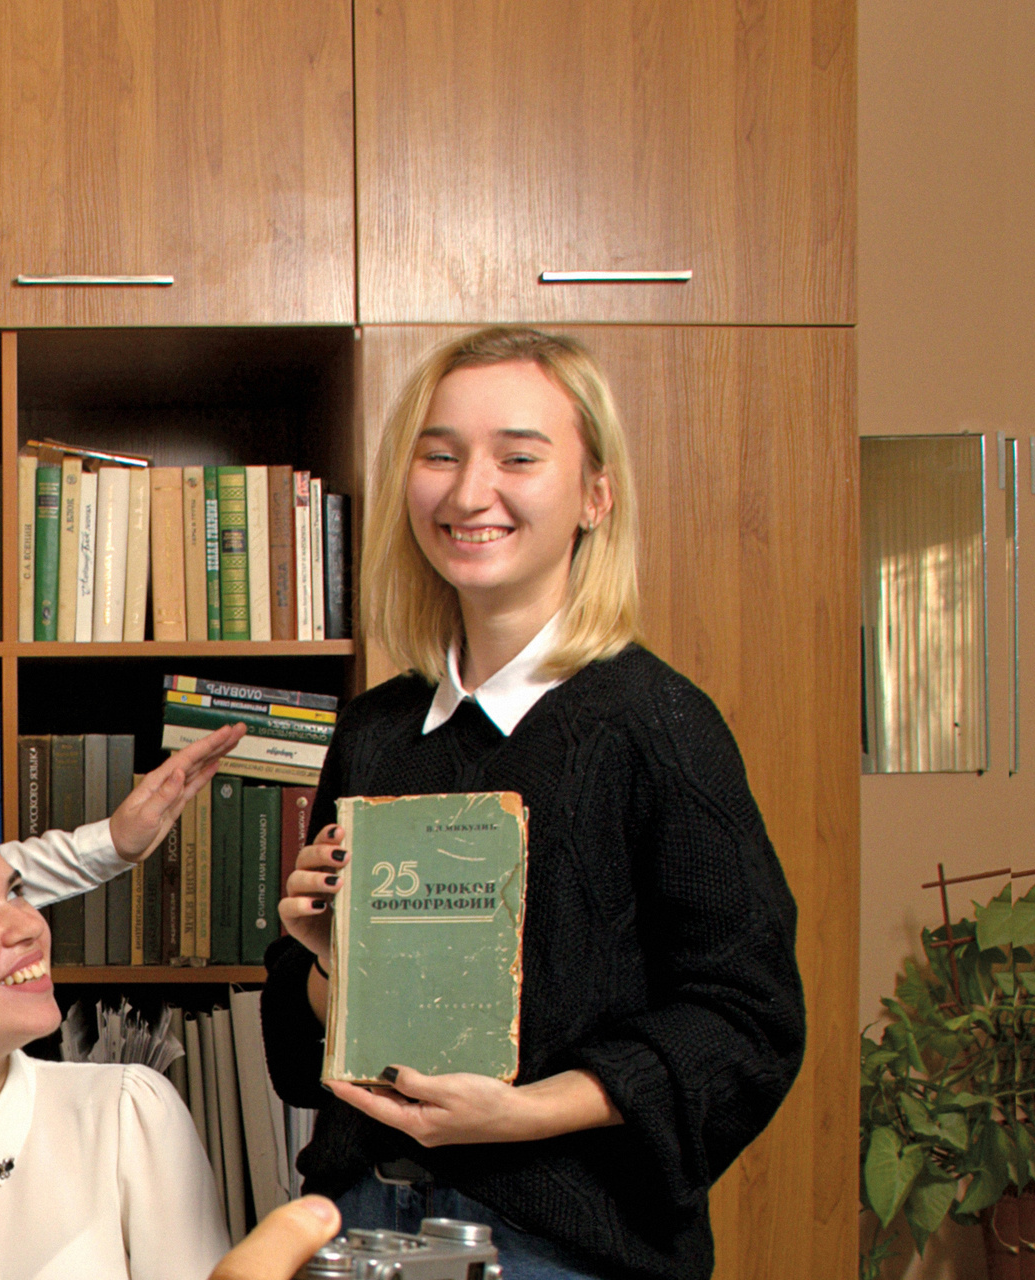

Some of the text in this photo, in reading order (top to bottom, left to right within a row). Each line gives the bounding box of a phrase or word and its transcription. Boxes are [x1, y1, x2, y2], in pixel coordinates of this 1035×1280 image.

[66, 498, 74, 523] БЛОК
[206, 499, 218, 539] ГВАРДИЯ
[23, 524, 32, 560] ЕСЕНИН
[207, 542, 219, 571] БЕЛАЯ
[206, 683, 263, 700] СЛОВАРЬ
[29, 747, 38, 834] РУССКОГО ЯЗЫКА
[371, 860, 496, 898] 25 УРОКОВ
[371, 898, 496, 911] ФОТОГРАФИИ
